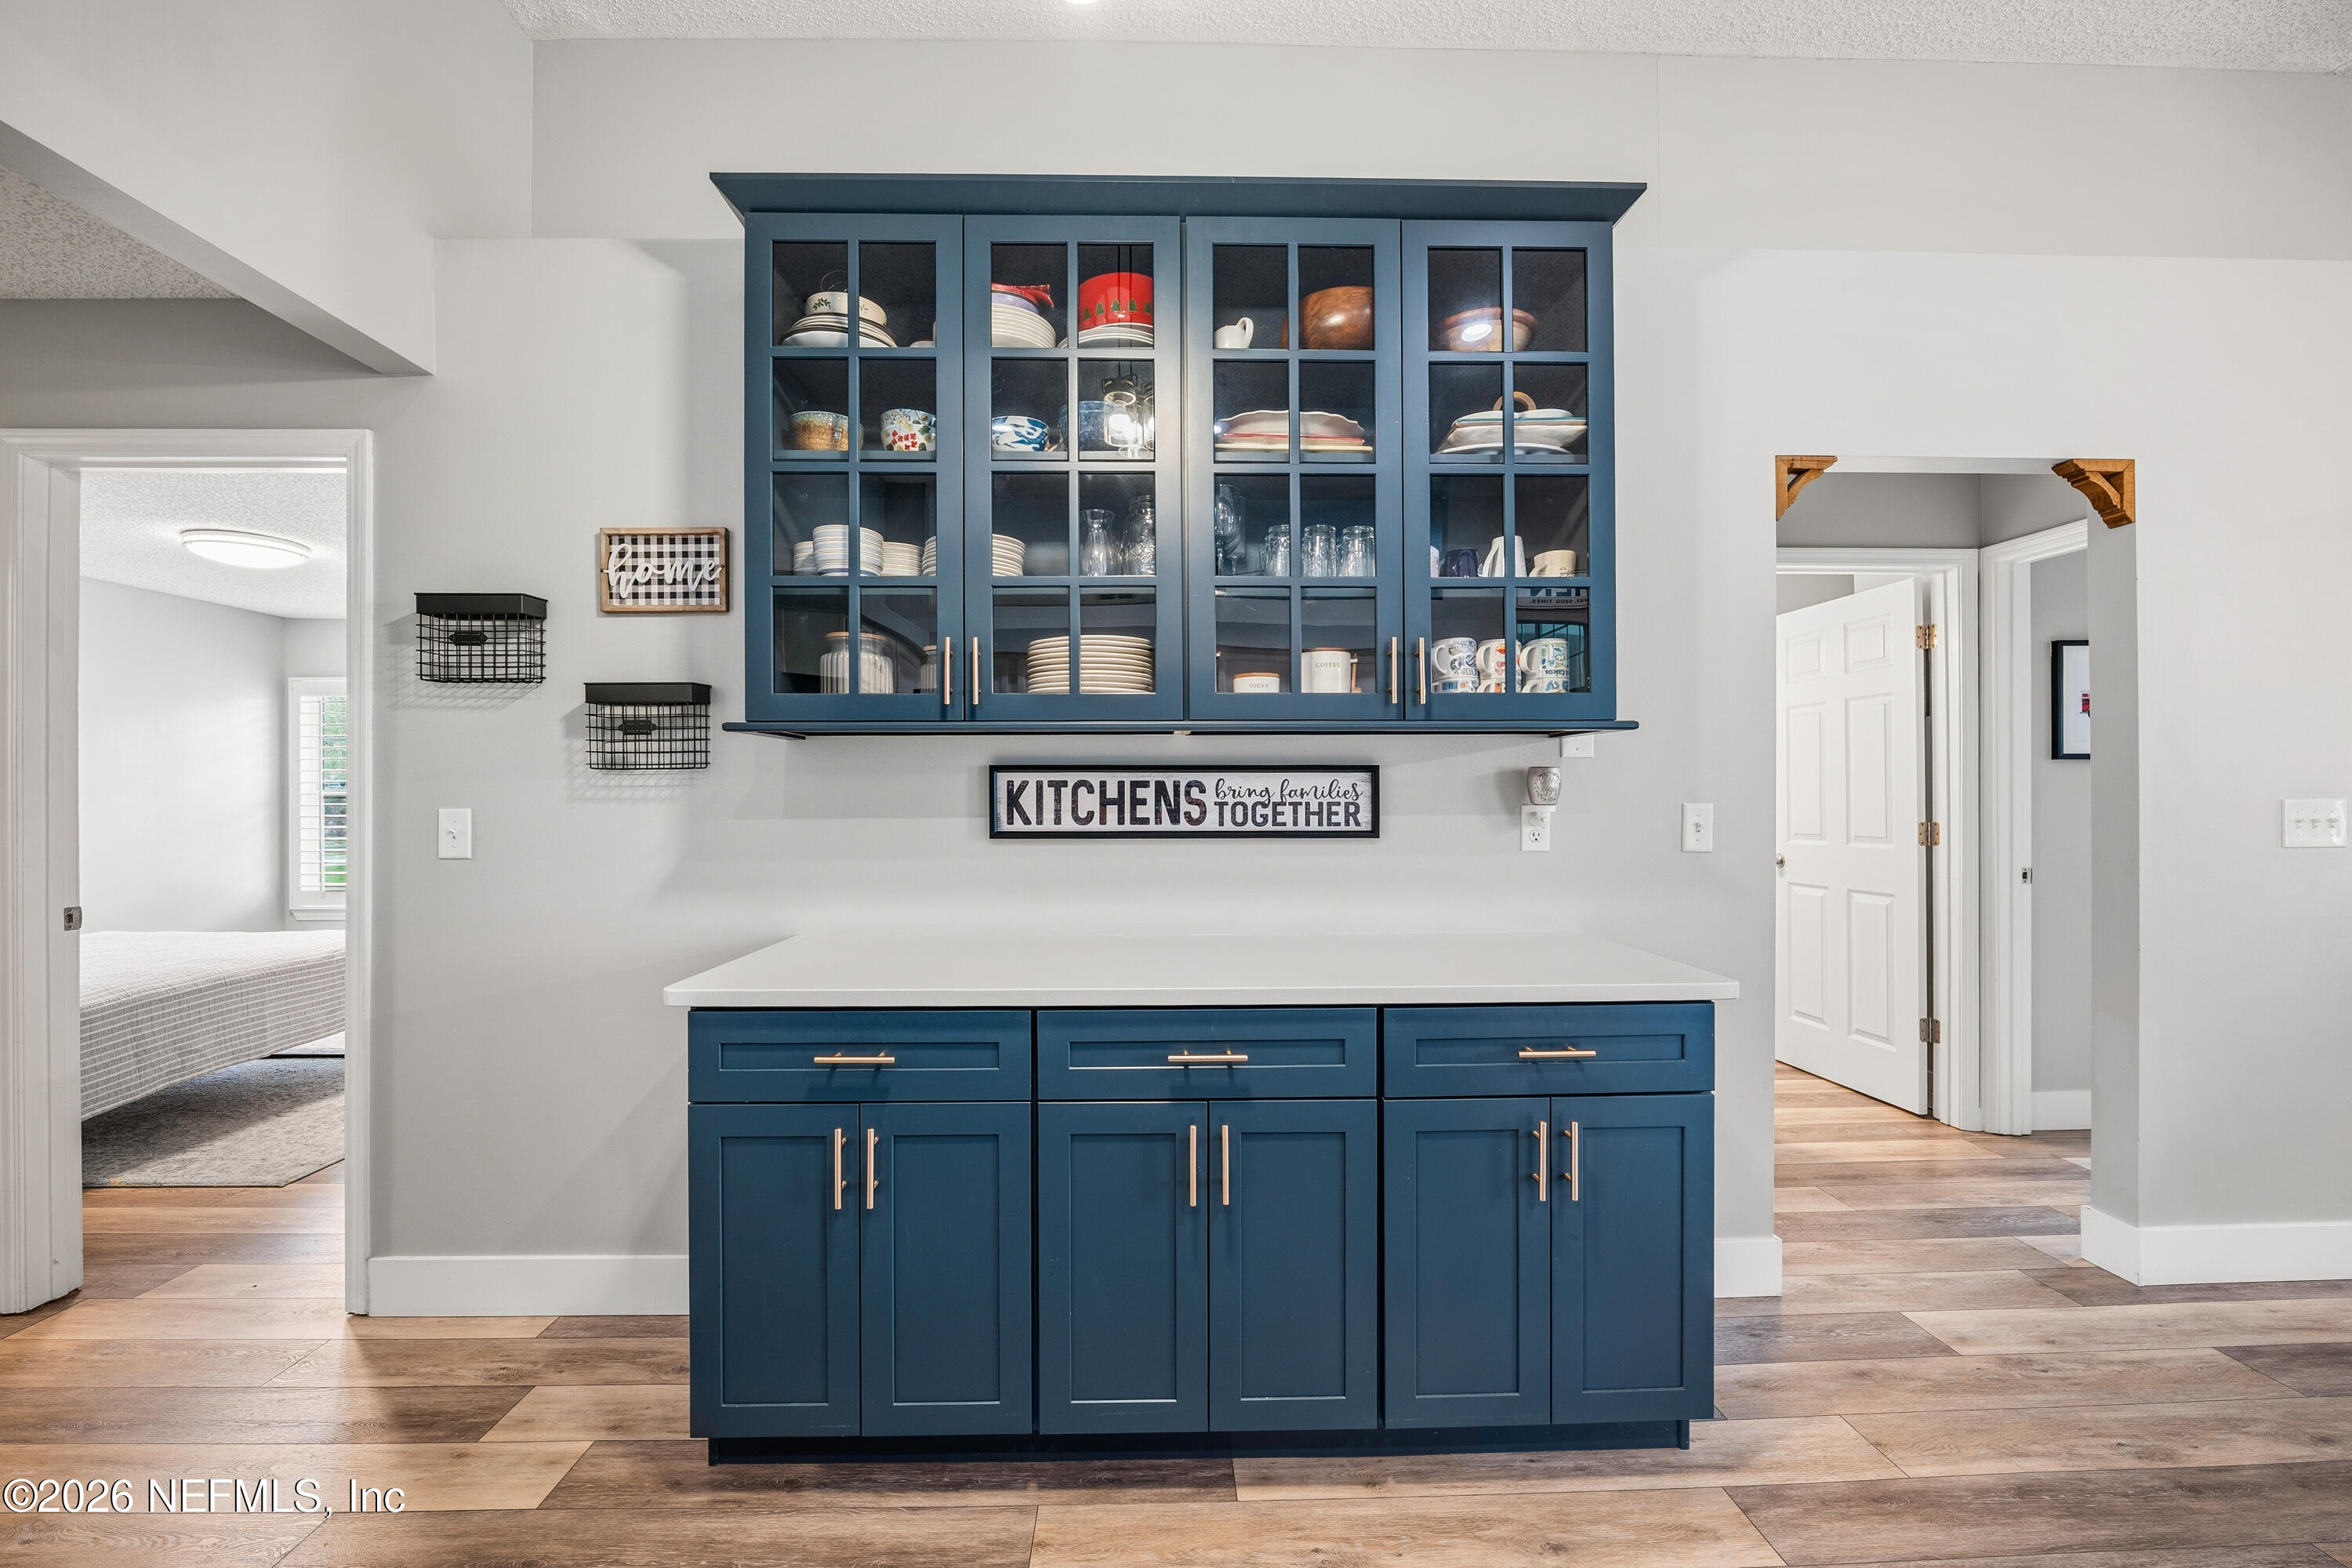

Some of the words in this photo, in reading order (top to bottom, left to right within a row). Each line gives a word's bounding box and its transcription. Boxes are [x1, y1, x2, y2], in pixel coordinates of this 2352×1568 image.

[604, 543, 724, 598] home
[1006, 779, 1207, 826] KITCHENS
[1215, 779, 1274, 803] bring
[1279, 779, 1362, 804] families
[1214, 801, 1360, 826] TOGETHER
